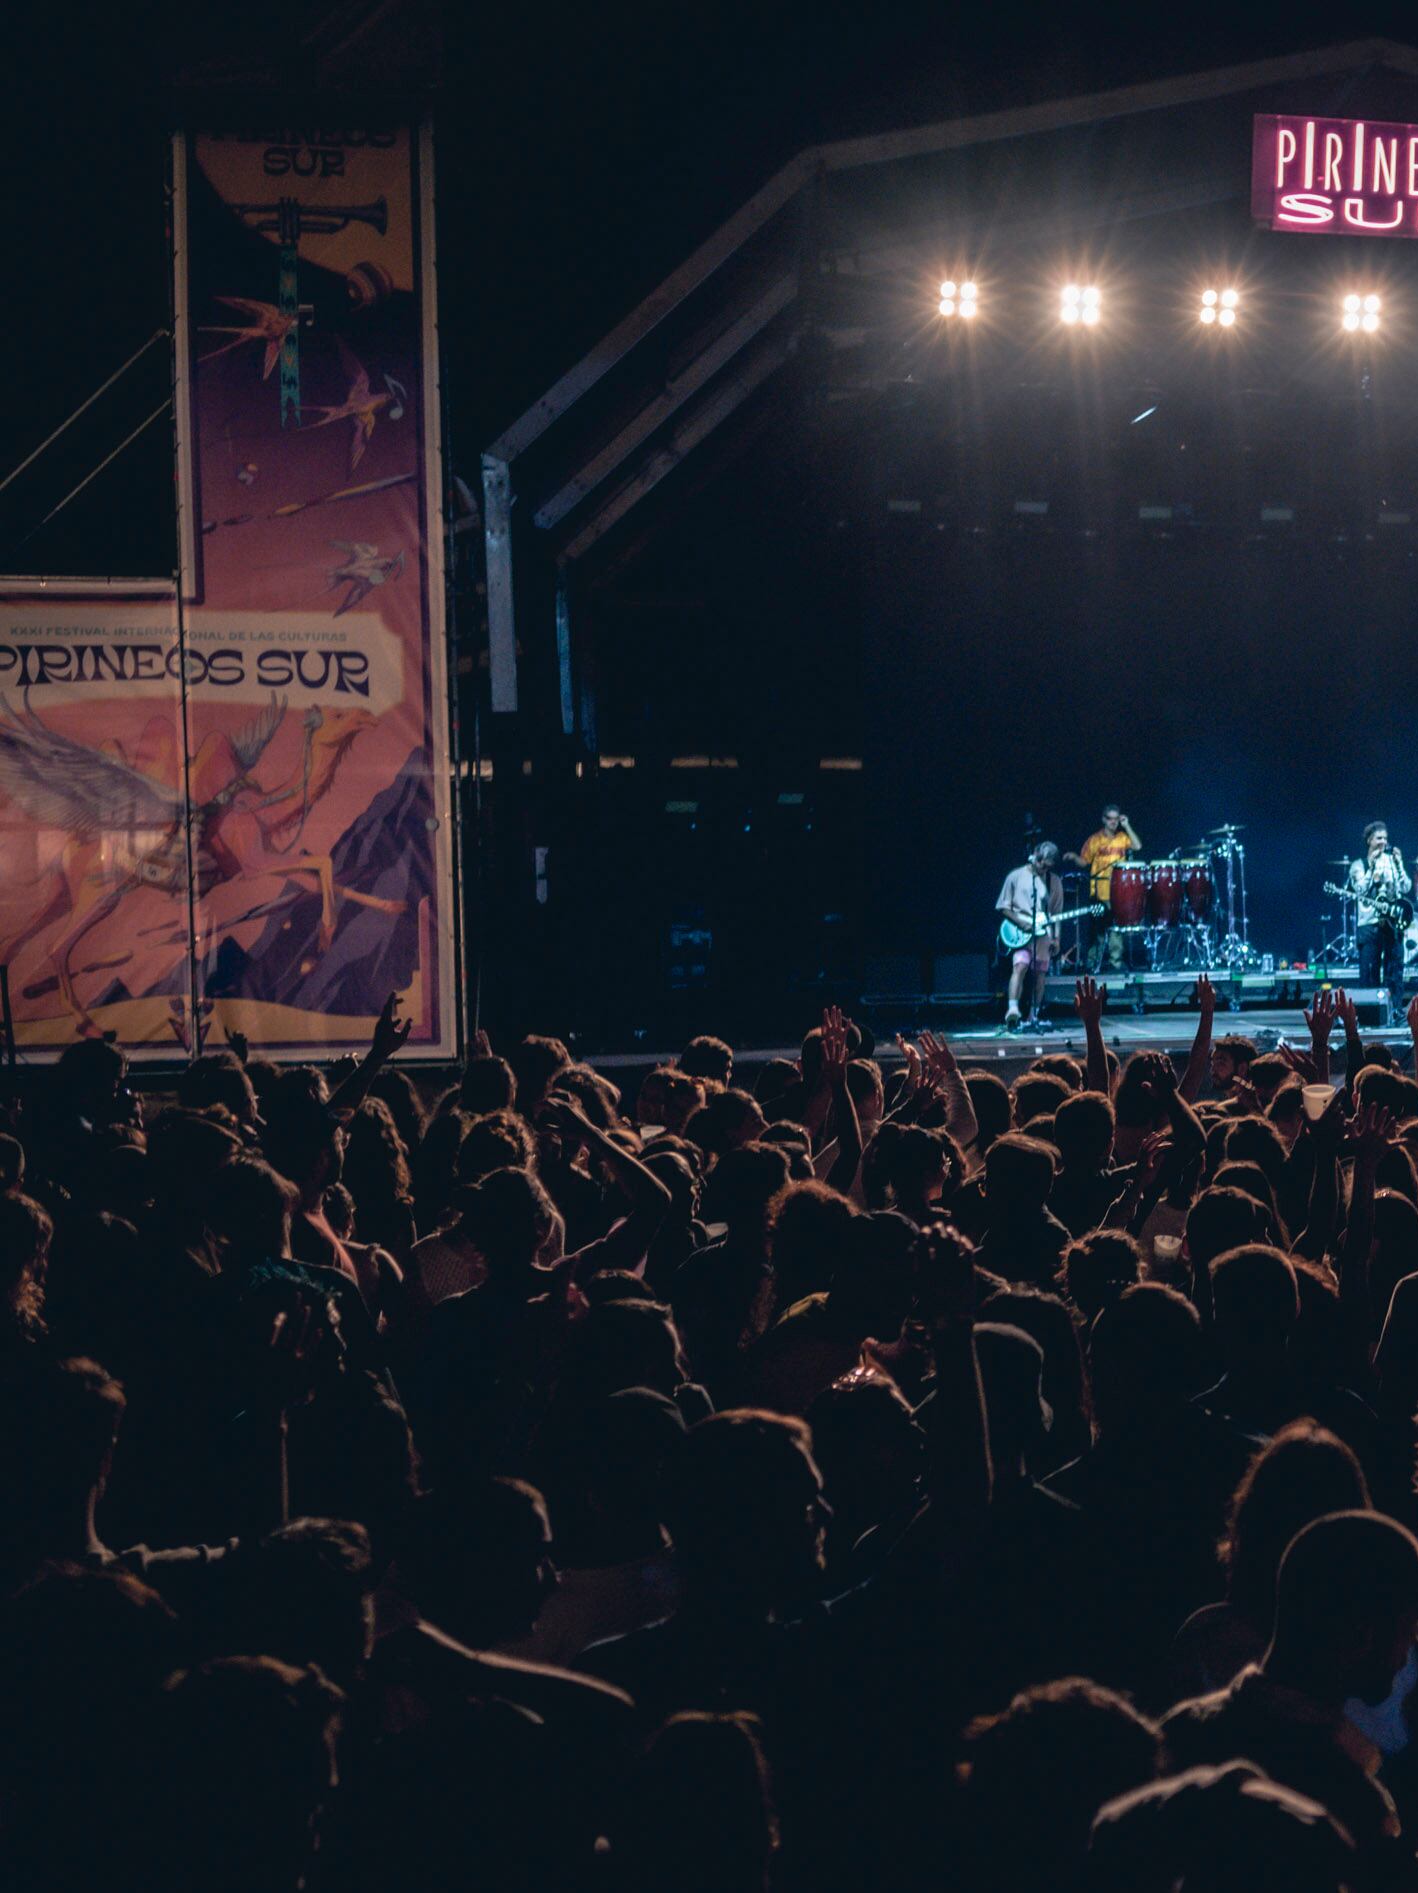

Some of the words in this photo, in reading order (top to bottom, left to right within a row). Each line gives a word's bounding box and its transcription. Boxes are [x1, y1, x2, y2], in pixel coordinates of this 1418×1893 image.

[263, 146, 346, 177] SUR
[46, 625, 109, 637] FESTIVAL
[228, 631, 246, 642] DE
[278, 631, 348, 643] CULTURAS
[256, 649, 371, 698] SUR
